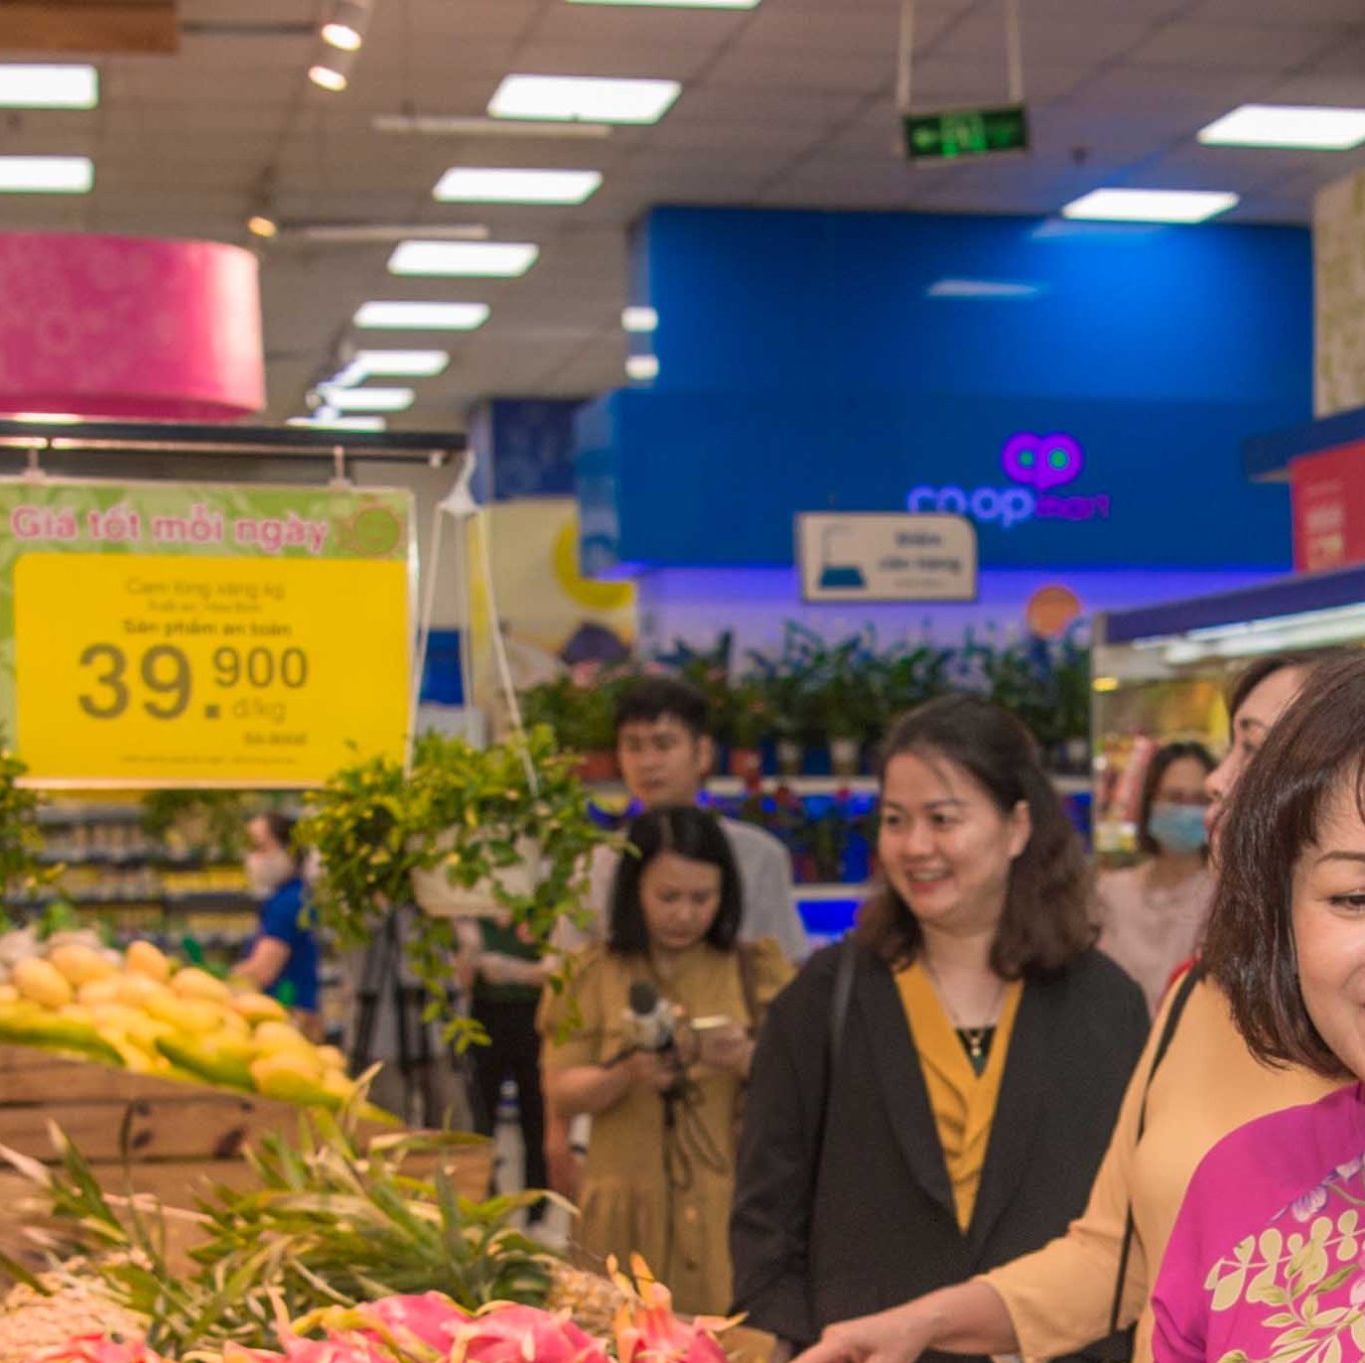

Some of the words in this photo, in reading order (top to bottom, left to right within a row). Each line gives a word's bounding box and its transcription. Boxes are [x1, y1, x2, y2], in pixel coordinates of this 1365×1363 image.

[10, 506, 77, 541] Giá
[88, 503, 141, 541] tốt
[152, 502, 223, 543] mỗi
[234, 511, 329, 554] ngày
